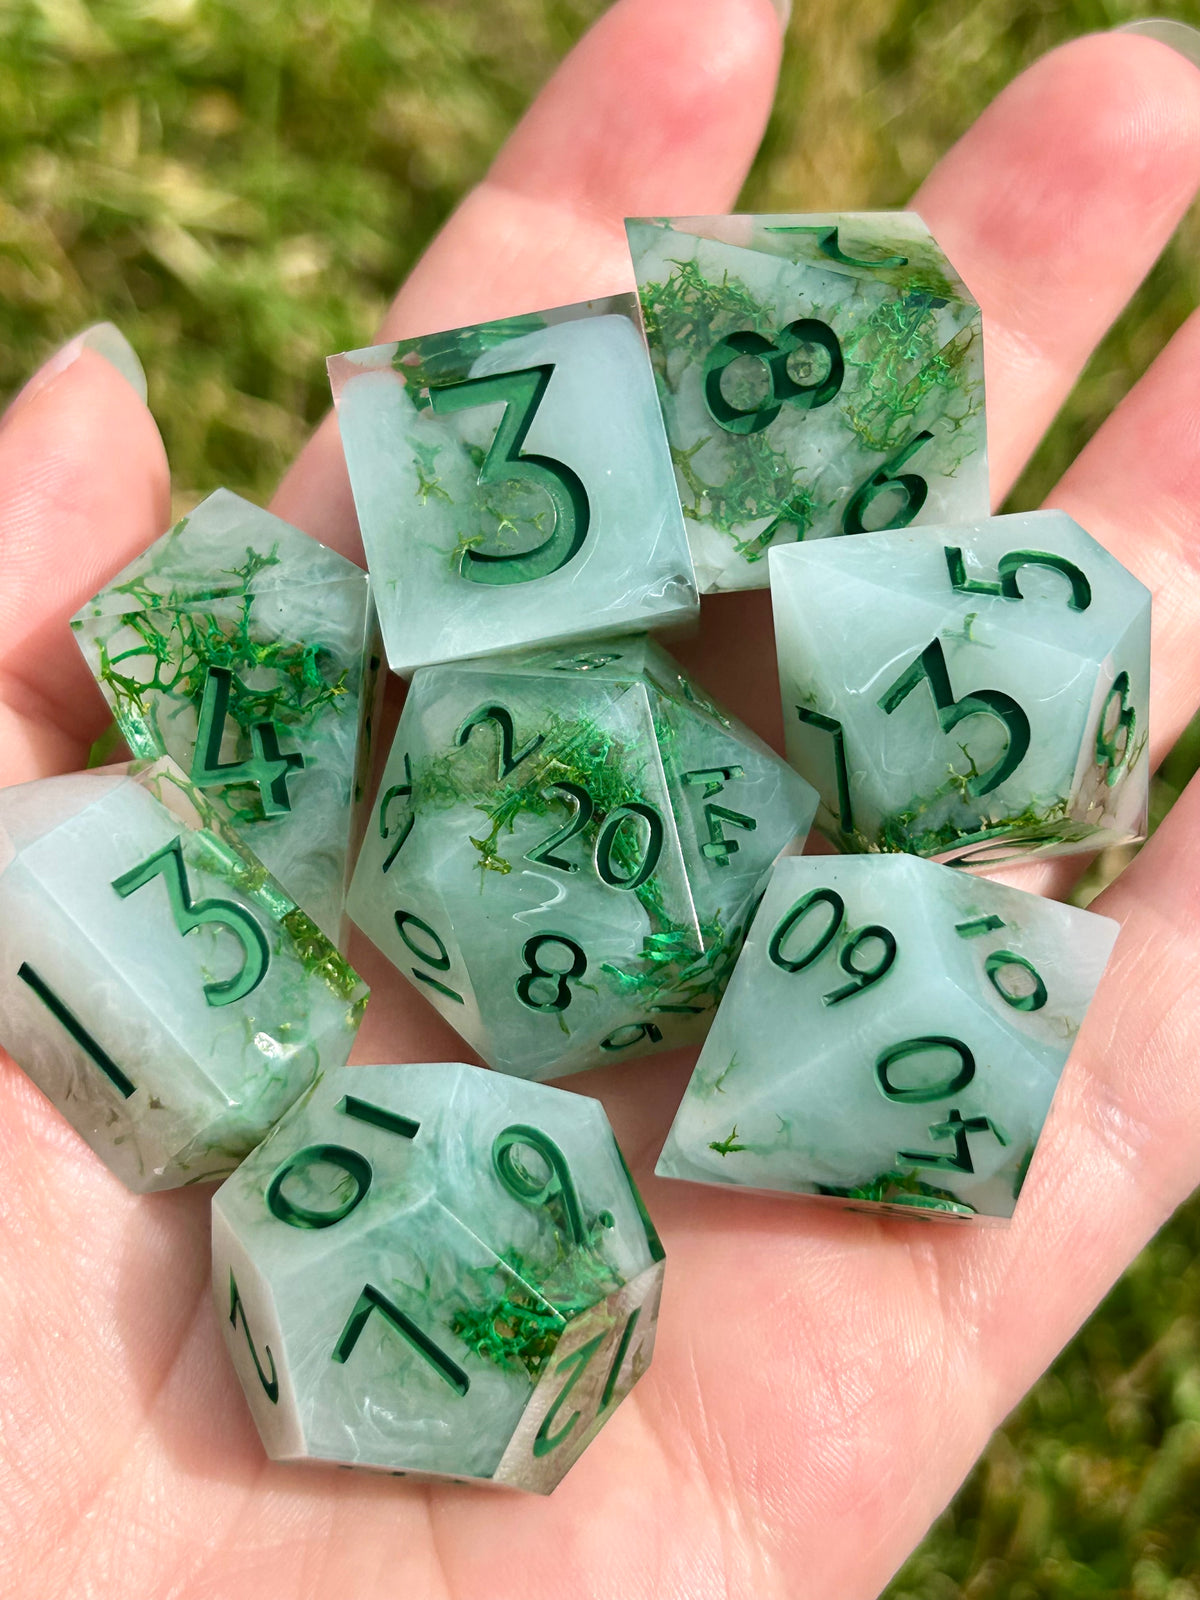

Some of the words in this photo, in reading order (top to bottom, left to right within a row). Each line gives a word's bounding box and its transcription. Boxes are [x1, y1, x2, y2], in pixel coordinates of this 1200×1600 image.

[703, 318, 845, 436] 8
[428, 362, 591, 588] 3
[841, 429, 935, 537] 6
[943, 545, 1093, 614] 5
[190, 665, 306, 817] 4
[454, 700, 544, 782] 2
[876, 636, 1032, 799] 3
[523, 781, 664, 891] 20
[680, 764, 758, 867] 14
[110, 834, 271, 1007] 3
[394, 909, 465, 1006] 10
[514, 929, 589, 1013] 8
[16, 960, 138, 1100] 1
[265, 1094, 422, 1230] 10
[873, 1035, 1011, 1174] 40
[330, 1283, 472, 1400] 7
